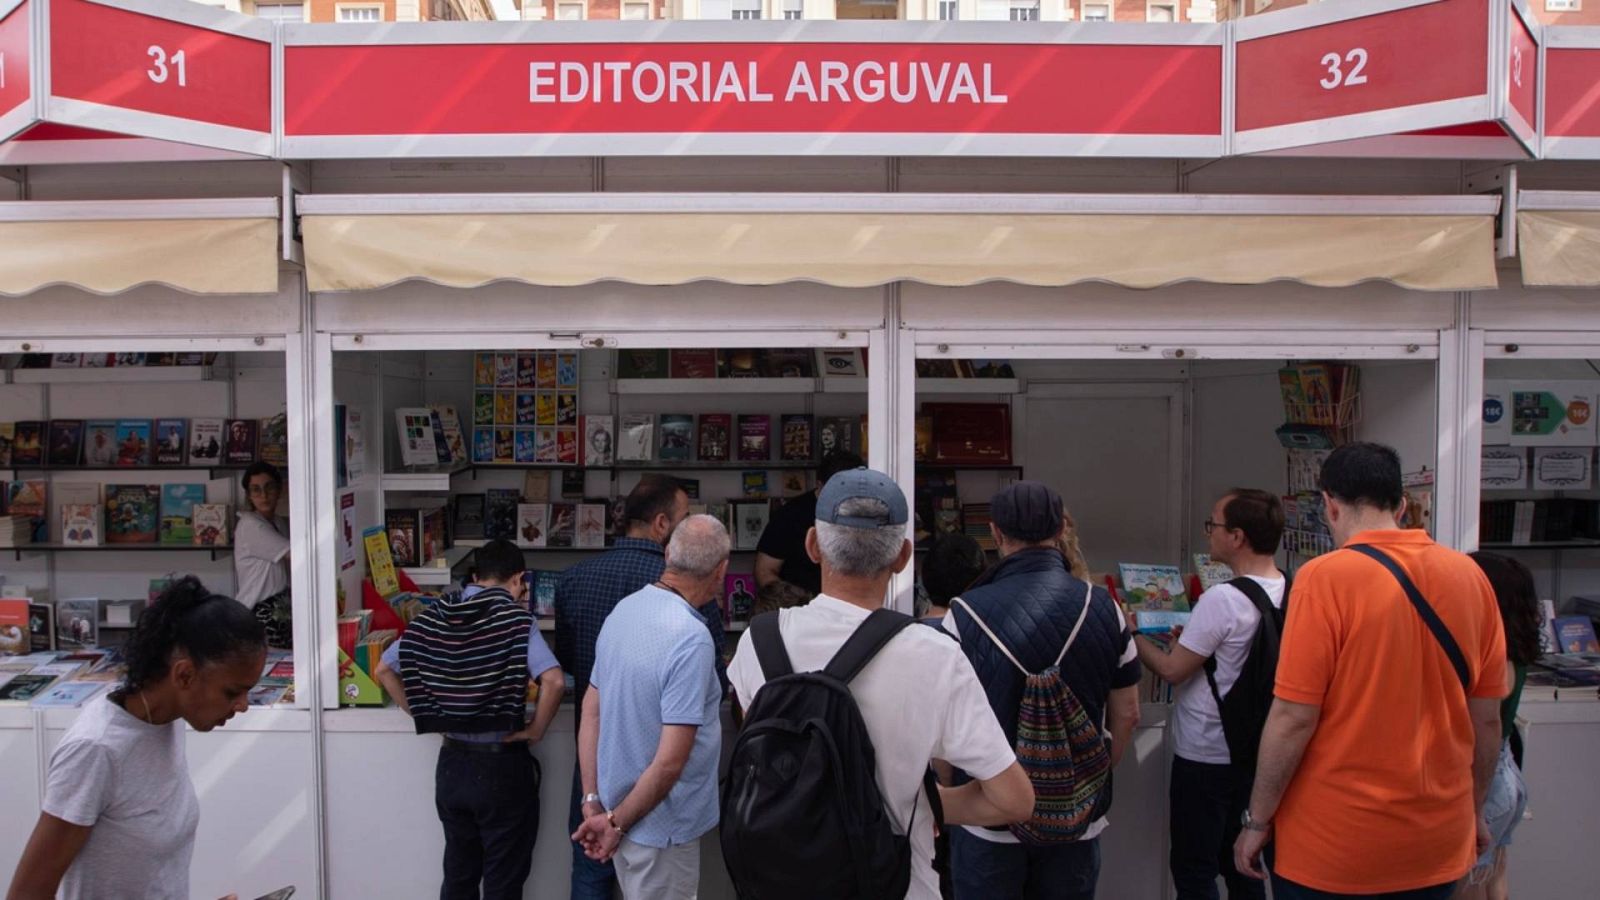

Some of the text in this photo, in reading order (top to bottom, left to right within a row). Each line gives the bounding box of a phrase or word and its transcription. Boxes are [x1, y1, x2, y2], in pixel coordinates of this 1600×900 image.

[147, 45, 187, 87] 31
[529, 61, 1008, 103] EDITORIAL ARGUVAL
[1320, 48, 1368, 90] 32
[1513, 45, 1522, 88] 32
